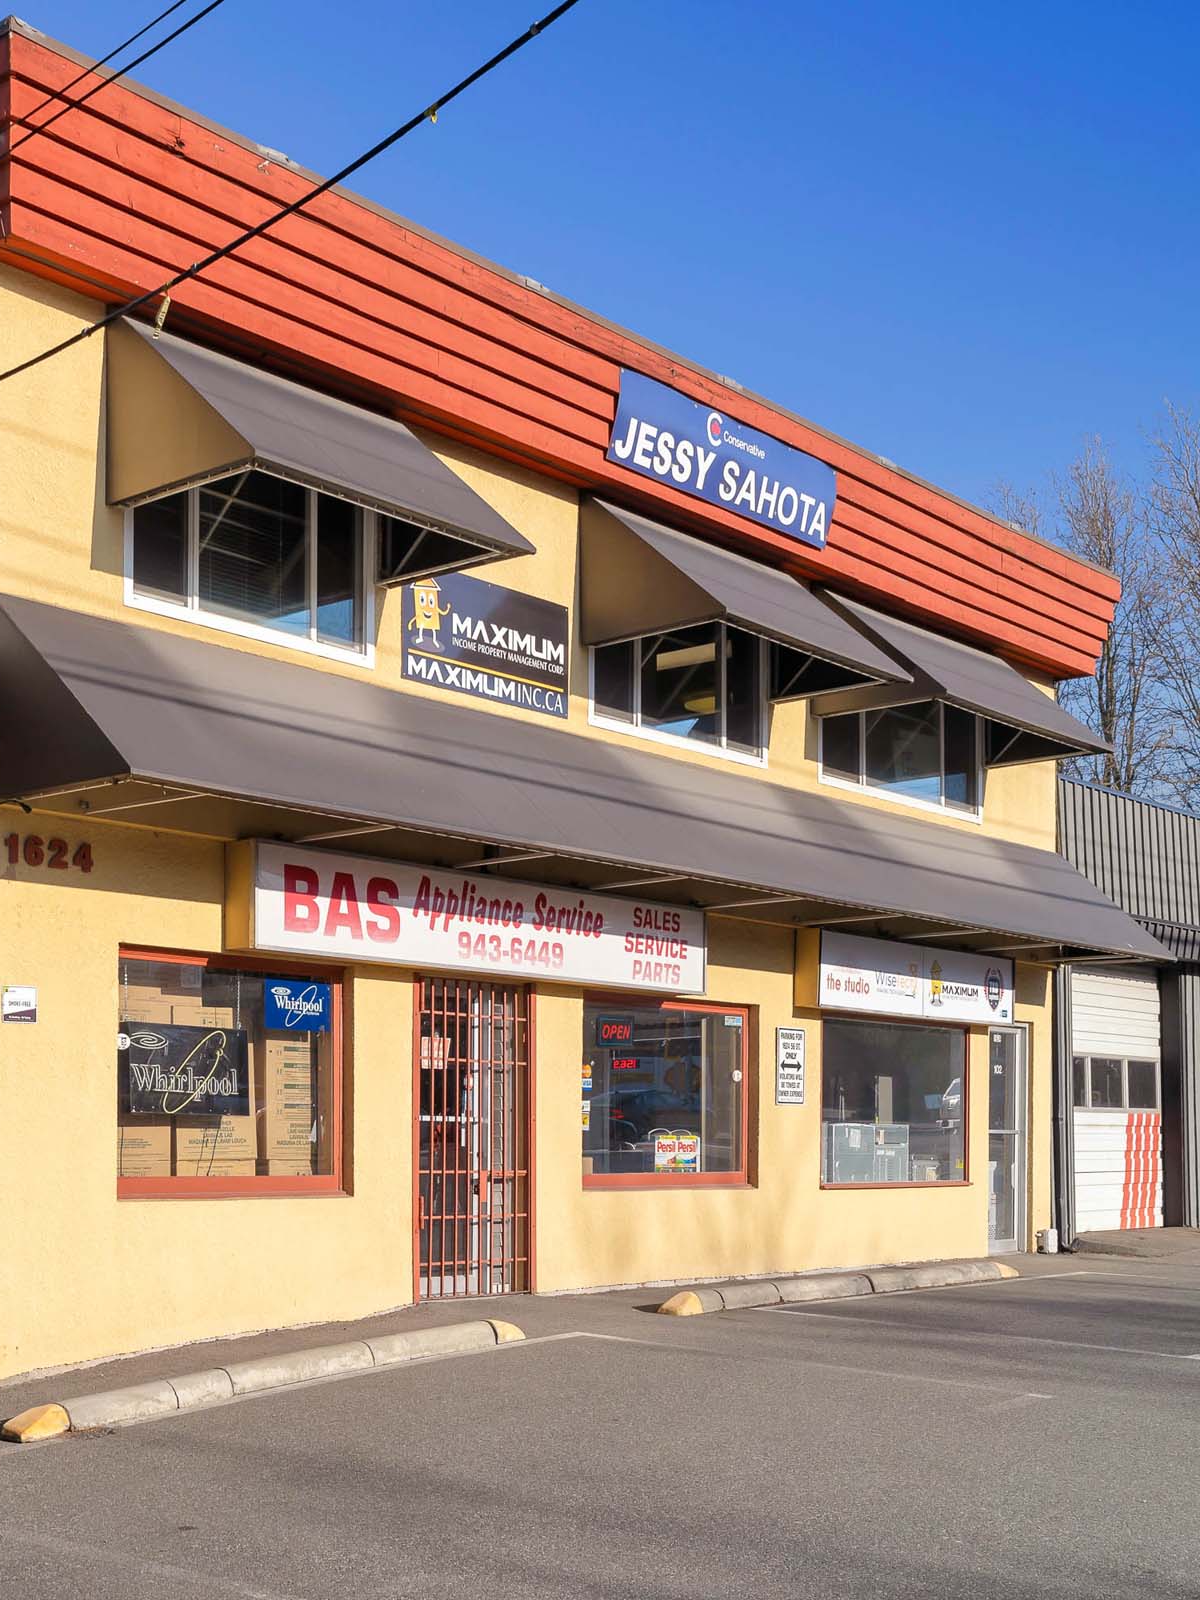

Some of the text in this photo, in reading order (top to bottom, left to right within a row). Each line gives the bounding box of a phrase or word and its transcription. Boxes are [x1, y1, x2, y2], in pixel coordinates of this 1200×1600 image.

[723, 431, 766, 460] Conservative
[614, 417, 827, 542] JESSY SAHOTA
[452, 612, 565, 666] MAXIMUM
[452, 636, 565, 676] INCOME PROPERTY MANAGEMENT CORP.
[4, 832, 94, 874] 1624
[283, 863, 605, 944] BAS Appliance Service
[633, 906, 681, 933] SALES
[457, 930, 565, 970] 943-6449
[624, 932, 688, 960] SERVICE
[632, 959, 681, 986] PARTS
[826, 972, 842, 991] the
[844, 976, 870, 994] studio
[274, 995, 323, 1014] Whirlpool
[941, 984, 979, 998] MAXIMUM
[602, 1023, 631, 1040] OPEN
[785, 1052, 797, 1060] ONLY
[130, 1063, 240, 1103] Whirlpool
[656, 1141, 676, 1153] Persil
[677, 1141, 697, 1153] Persil
